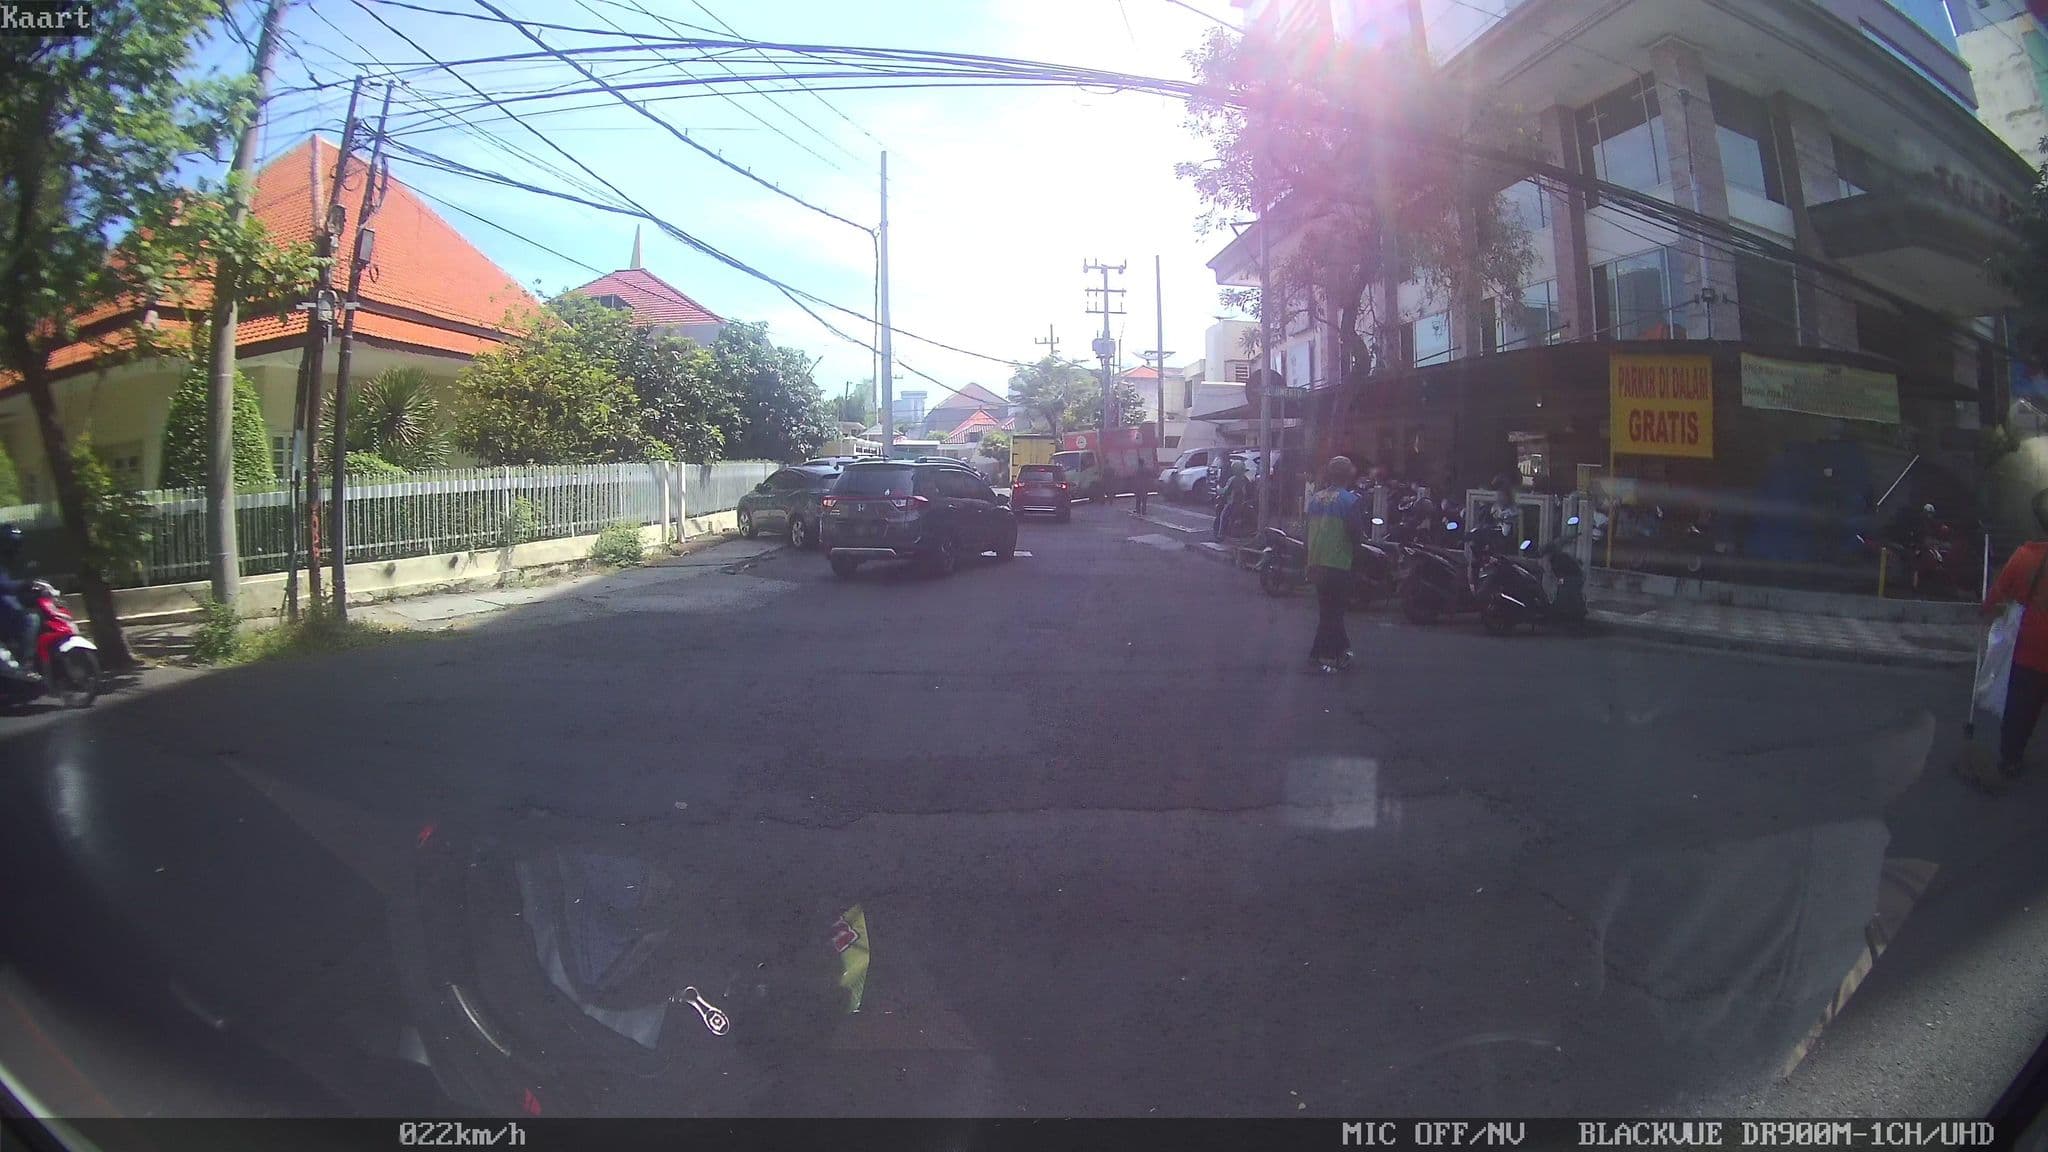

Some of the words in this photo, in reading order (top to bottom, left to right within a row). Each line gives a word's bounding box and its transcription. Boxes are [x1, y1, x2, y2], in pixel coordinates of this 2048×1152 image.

[1617, 366, 1656, 399] PARKIR
[1659, 366, 1669, 399] DI
[1672, 366, 1709, 401] DALAM
[1628, 408, 1700, 445] GRATIS
